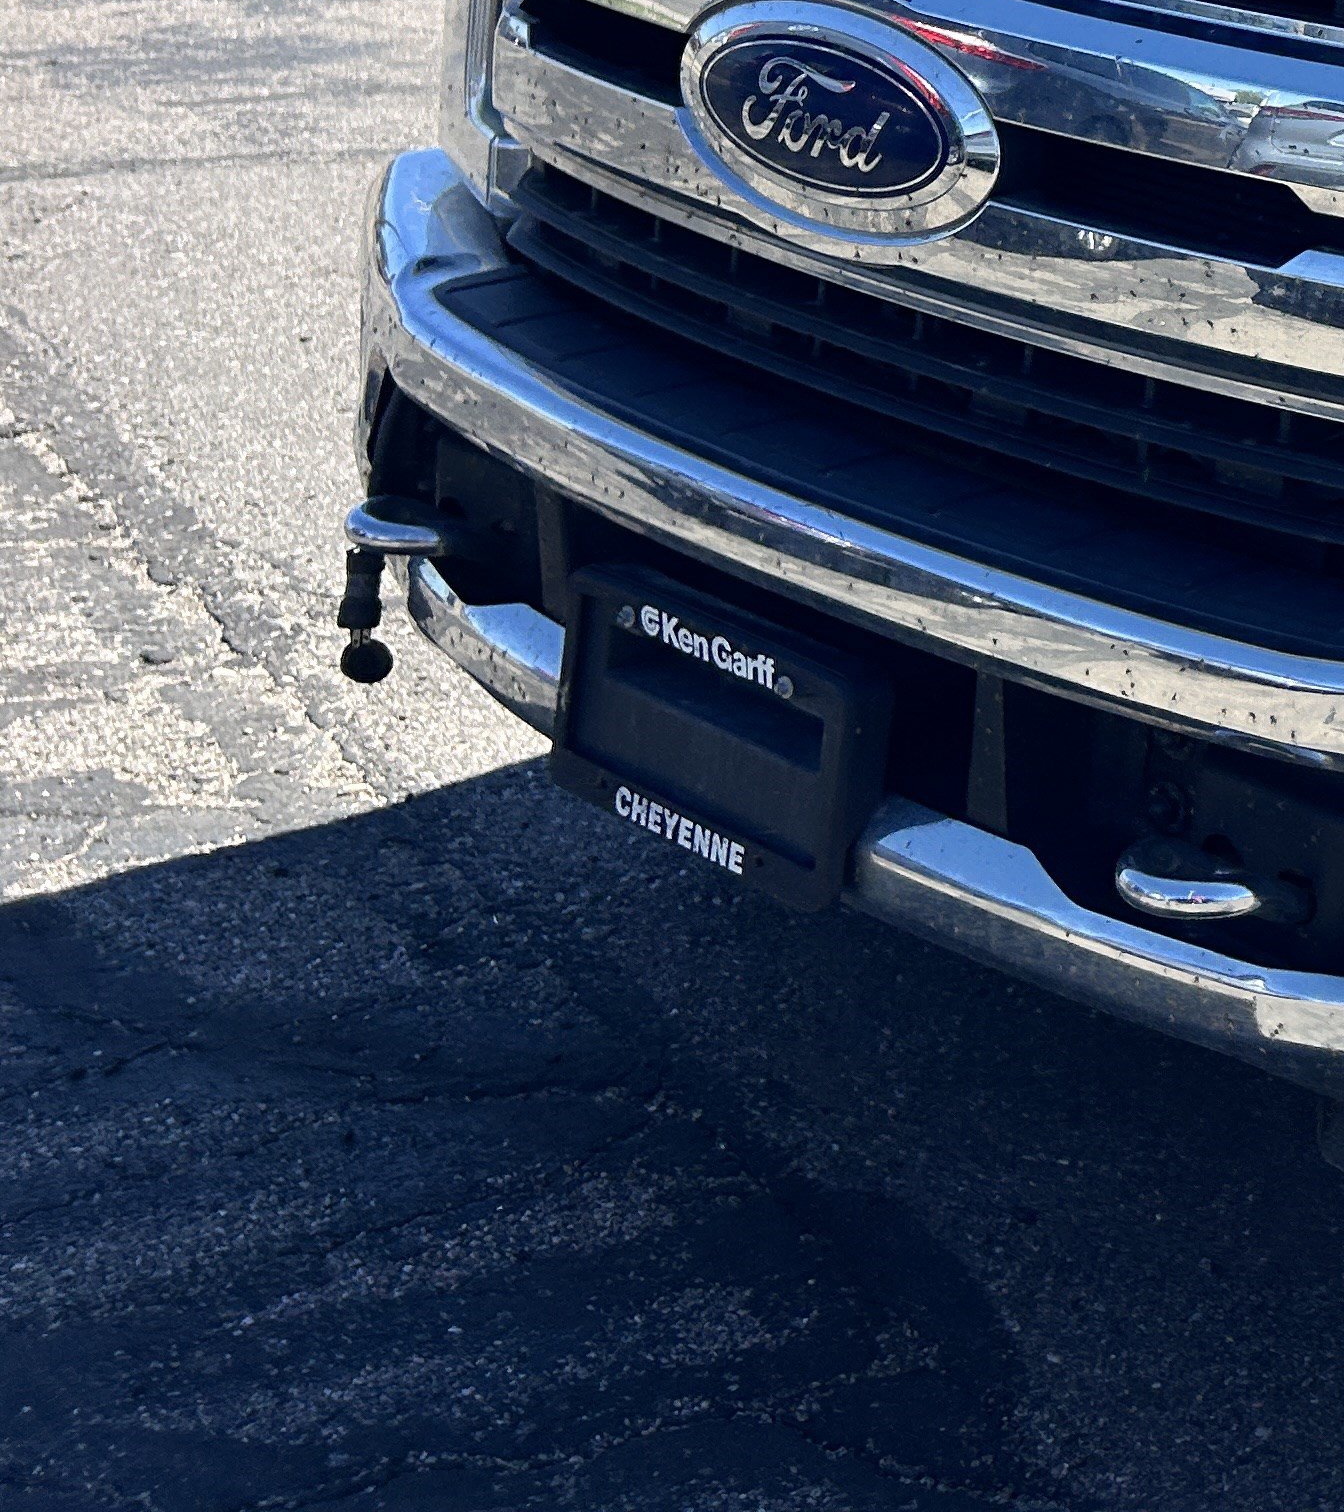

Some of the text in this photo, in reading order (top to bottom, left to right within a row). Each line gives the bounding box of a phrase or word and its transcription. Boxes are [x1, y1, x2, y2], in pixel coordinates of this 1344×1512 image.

[741, 56, 891, 173] Ford
[661, 611, 775, 689] Ken Garff
[615, 786, 745, 875] CHEYENNE
